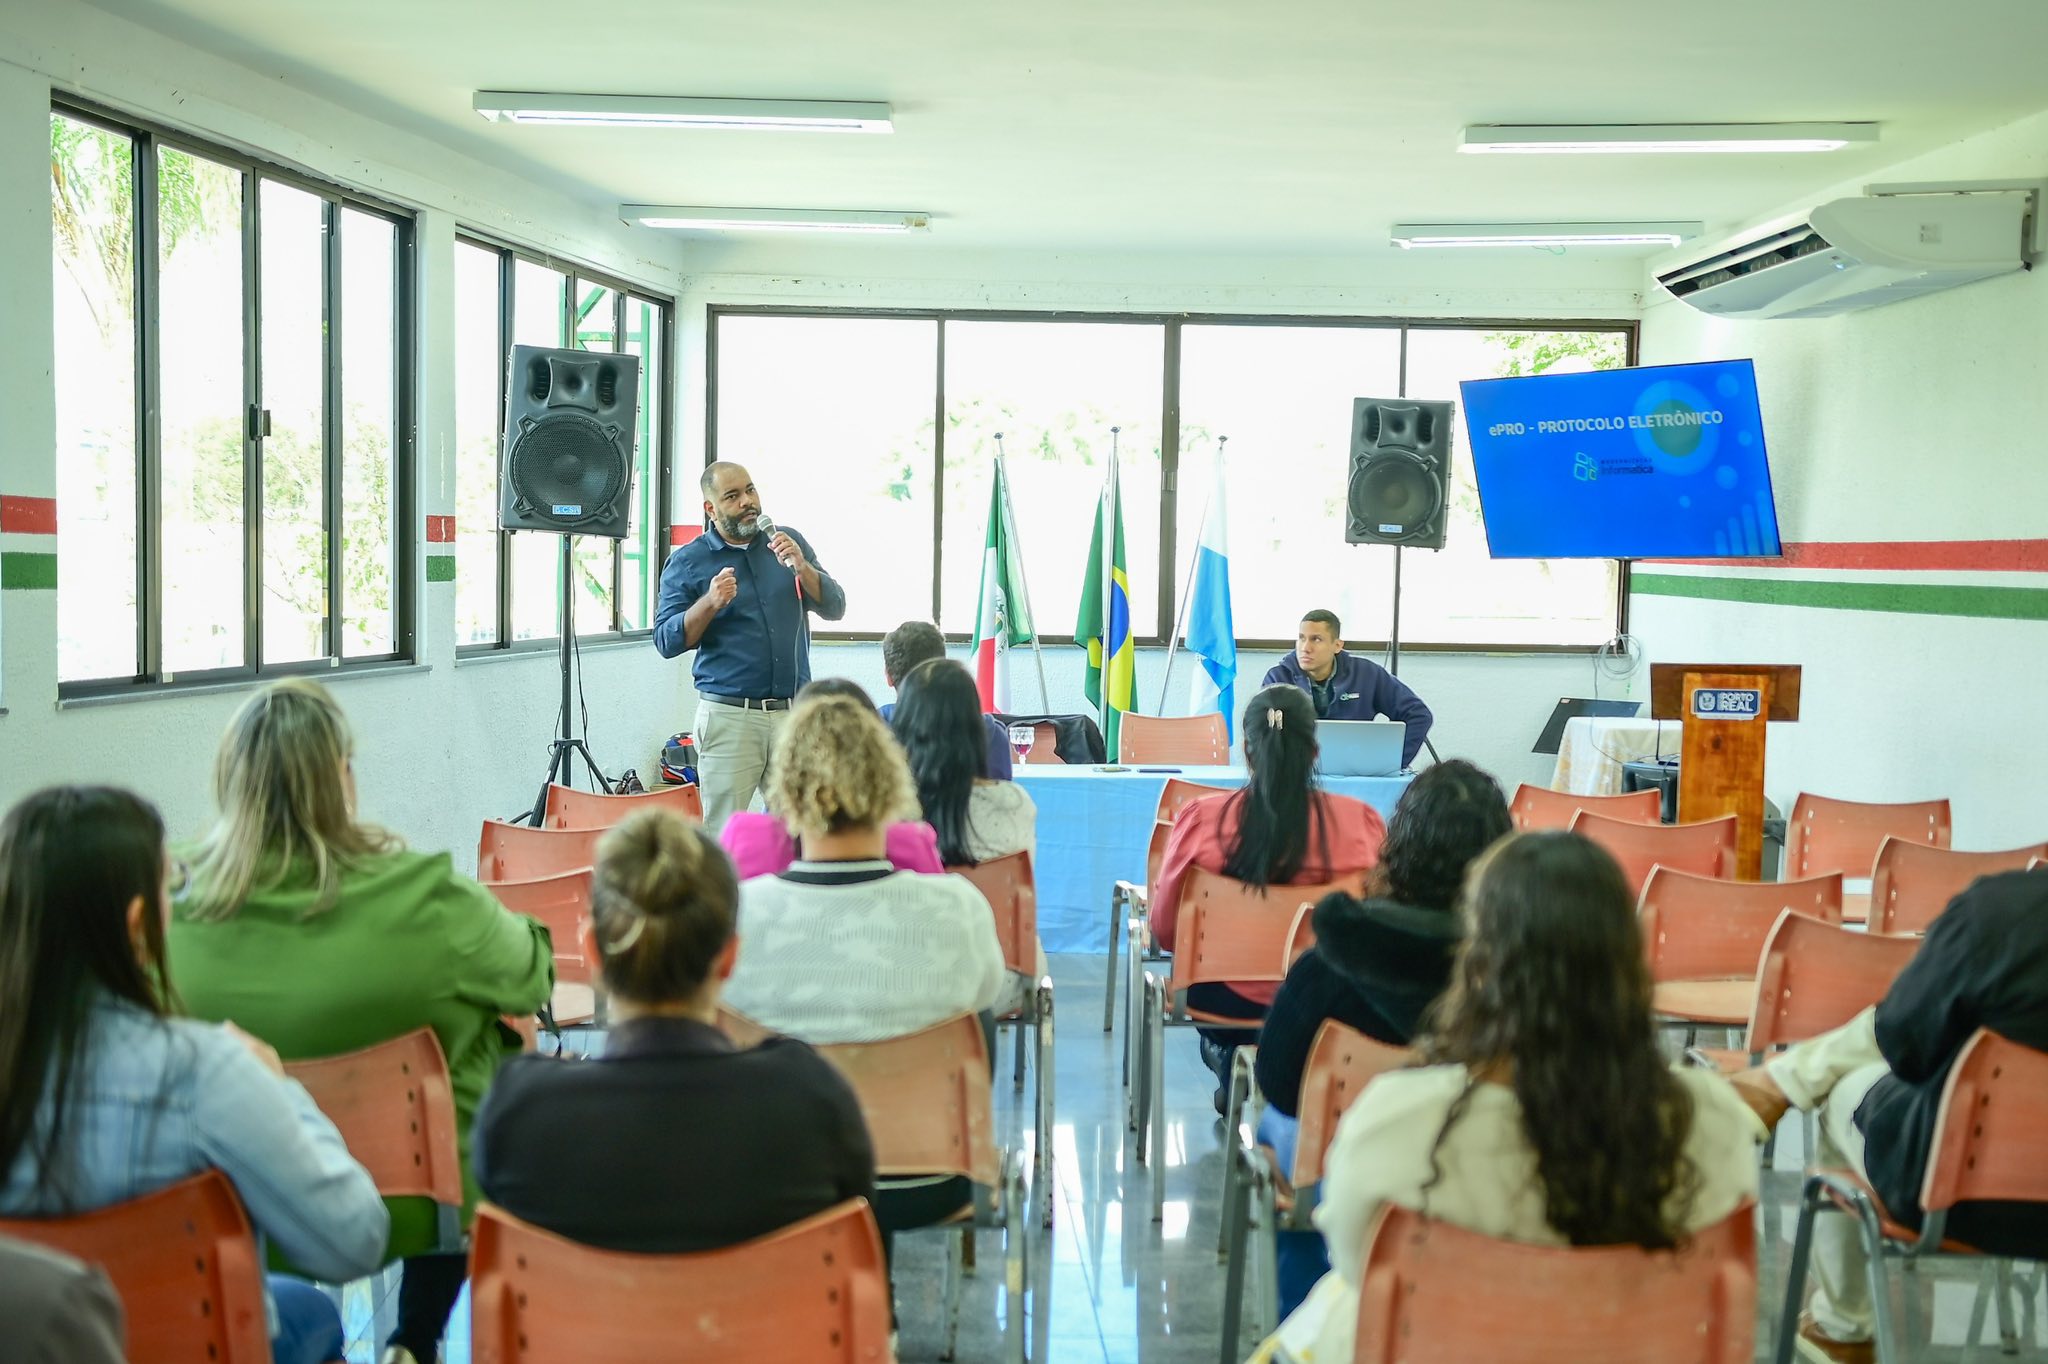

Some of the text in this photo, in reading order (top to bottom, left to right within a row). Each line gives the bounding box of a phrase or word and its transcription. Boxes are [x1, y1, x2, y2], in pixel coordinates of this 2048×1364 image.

[1489, 422, 1525, 436] ePRO
[1538, 416, 1625, 433] PROTOCOLO
[1628, 410, 1723, 428] ELETRÔNICO
[1721, 692, 1754, 702] PORTO
[1721, 701, 1753, 711] REAL
